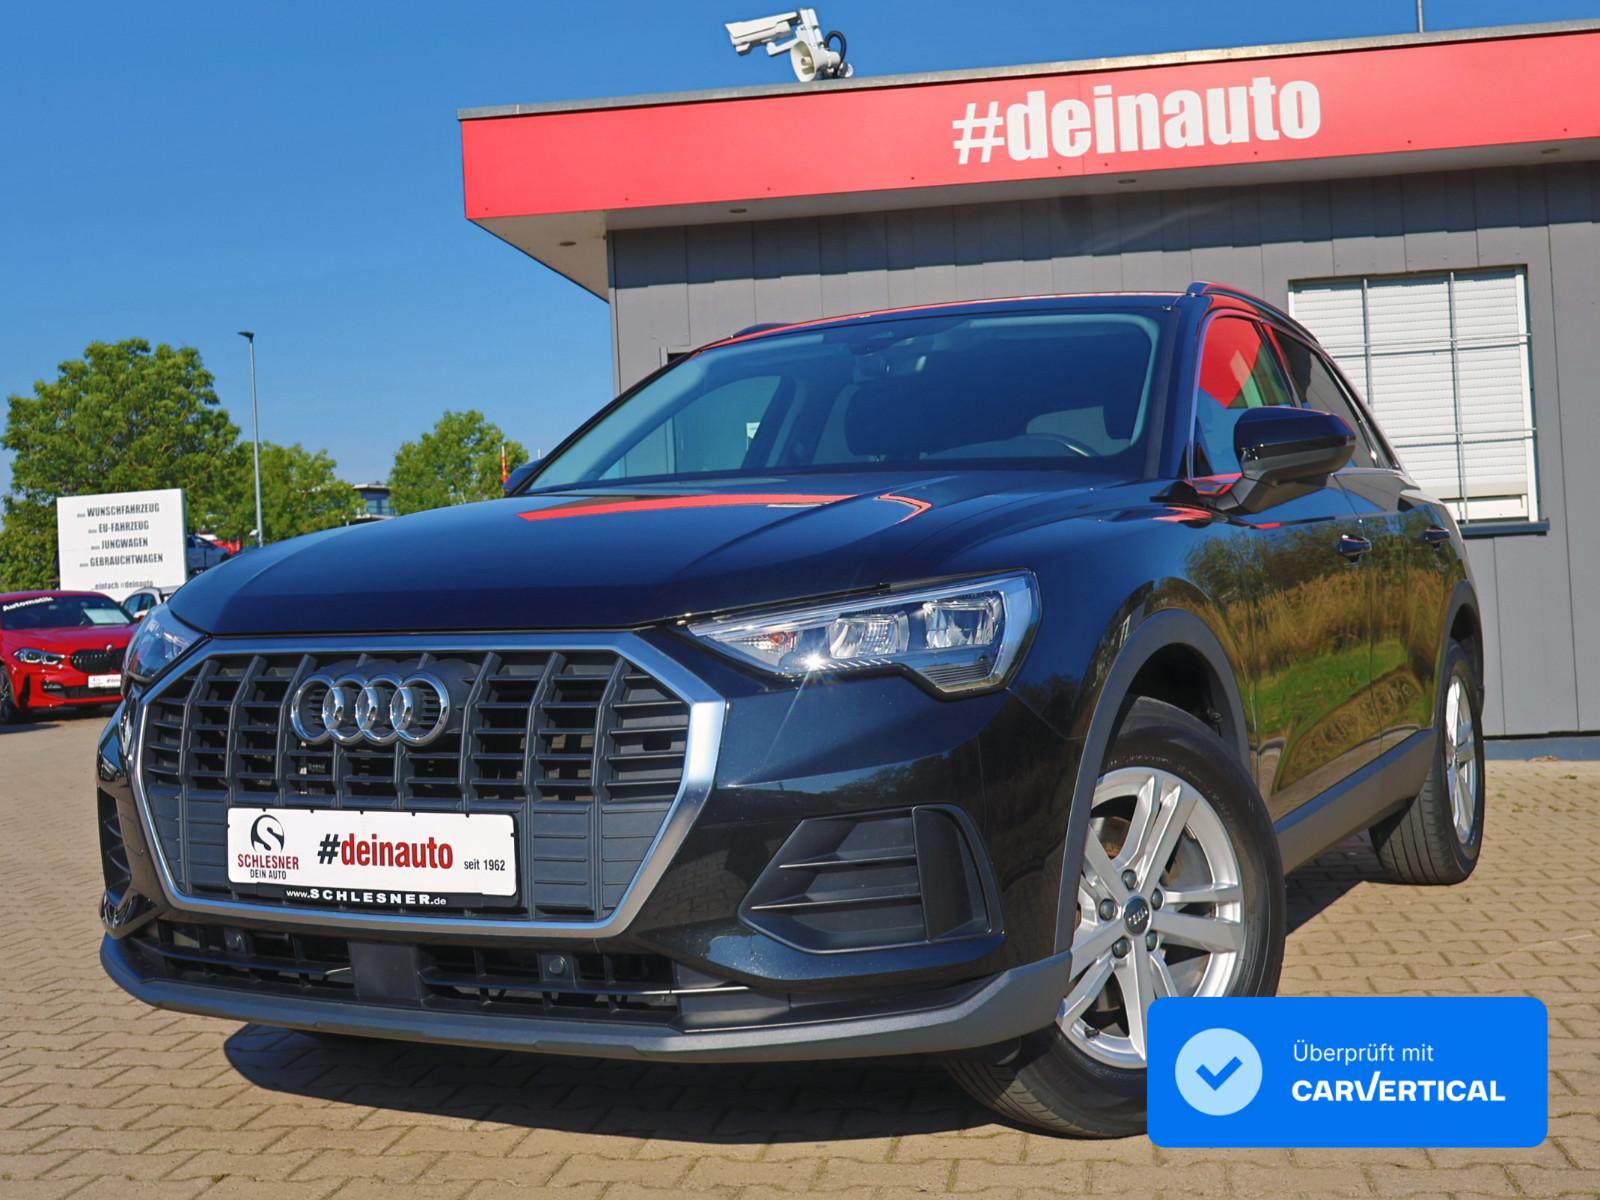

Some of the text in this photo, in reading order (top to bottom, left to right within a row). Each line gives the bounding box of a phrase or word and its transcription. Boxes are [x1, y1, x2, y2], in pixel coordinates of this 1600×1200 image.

[952, 76, 1321, 165] #deinauto
[87, 502, 160, 517] WUNSCHFAHRZEUG
[98, 520, 149, 533] EU-FAHRZEUG
[101, 537, 148, 550] JUNGWAGEN
[90, 553, 163, 567] GEBRAUCHTWAGEN
[317, 833, 506, 871] #deinauto seit 1962
[237, 853, 299, 870] SCHLESNER
[250, 869, 287, 880] DEIN AUTO
[286, 888, 447, 906] www.SCHLESNER.de
